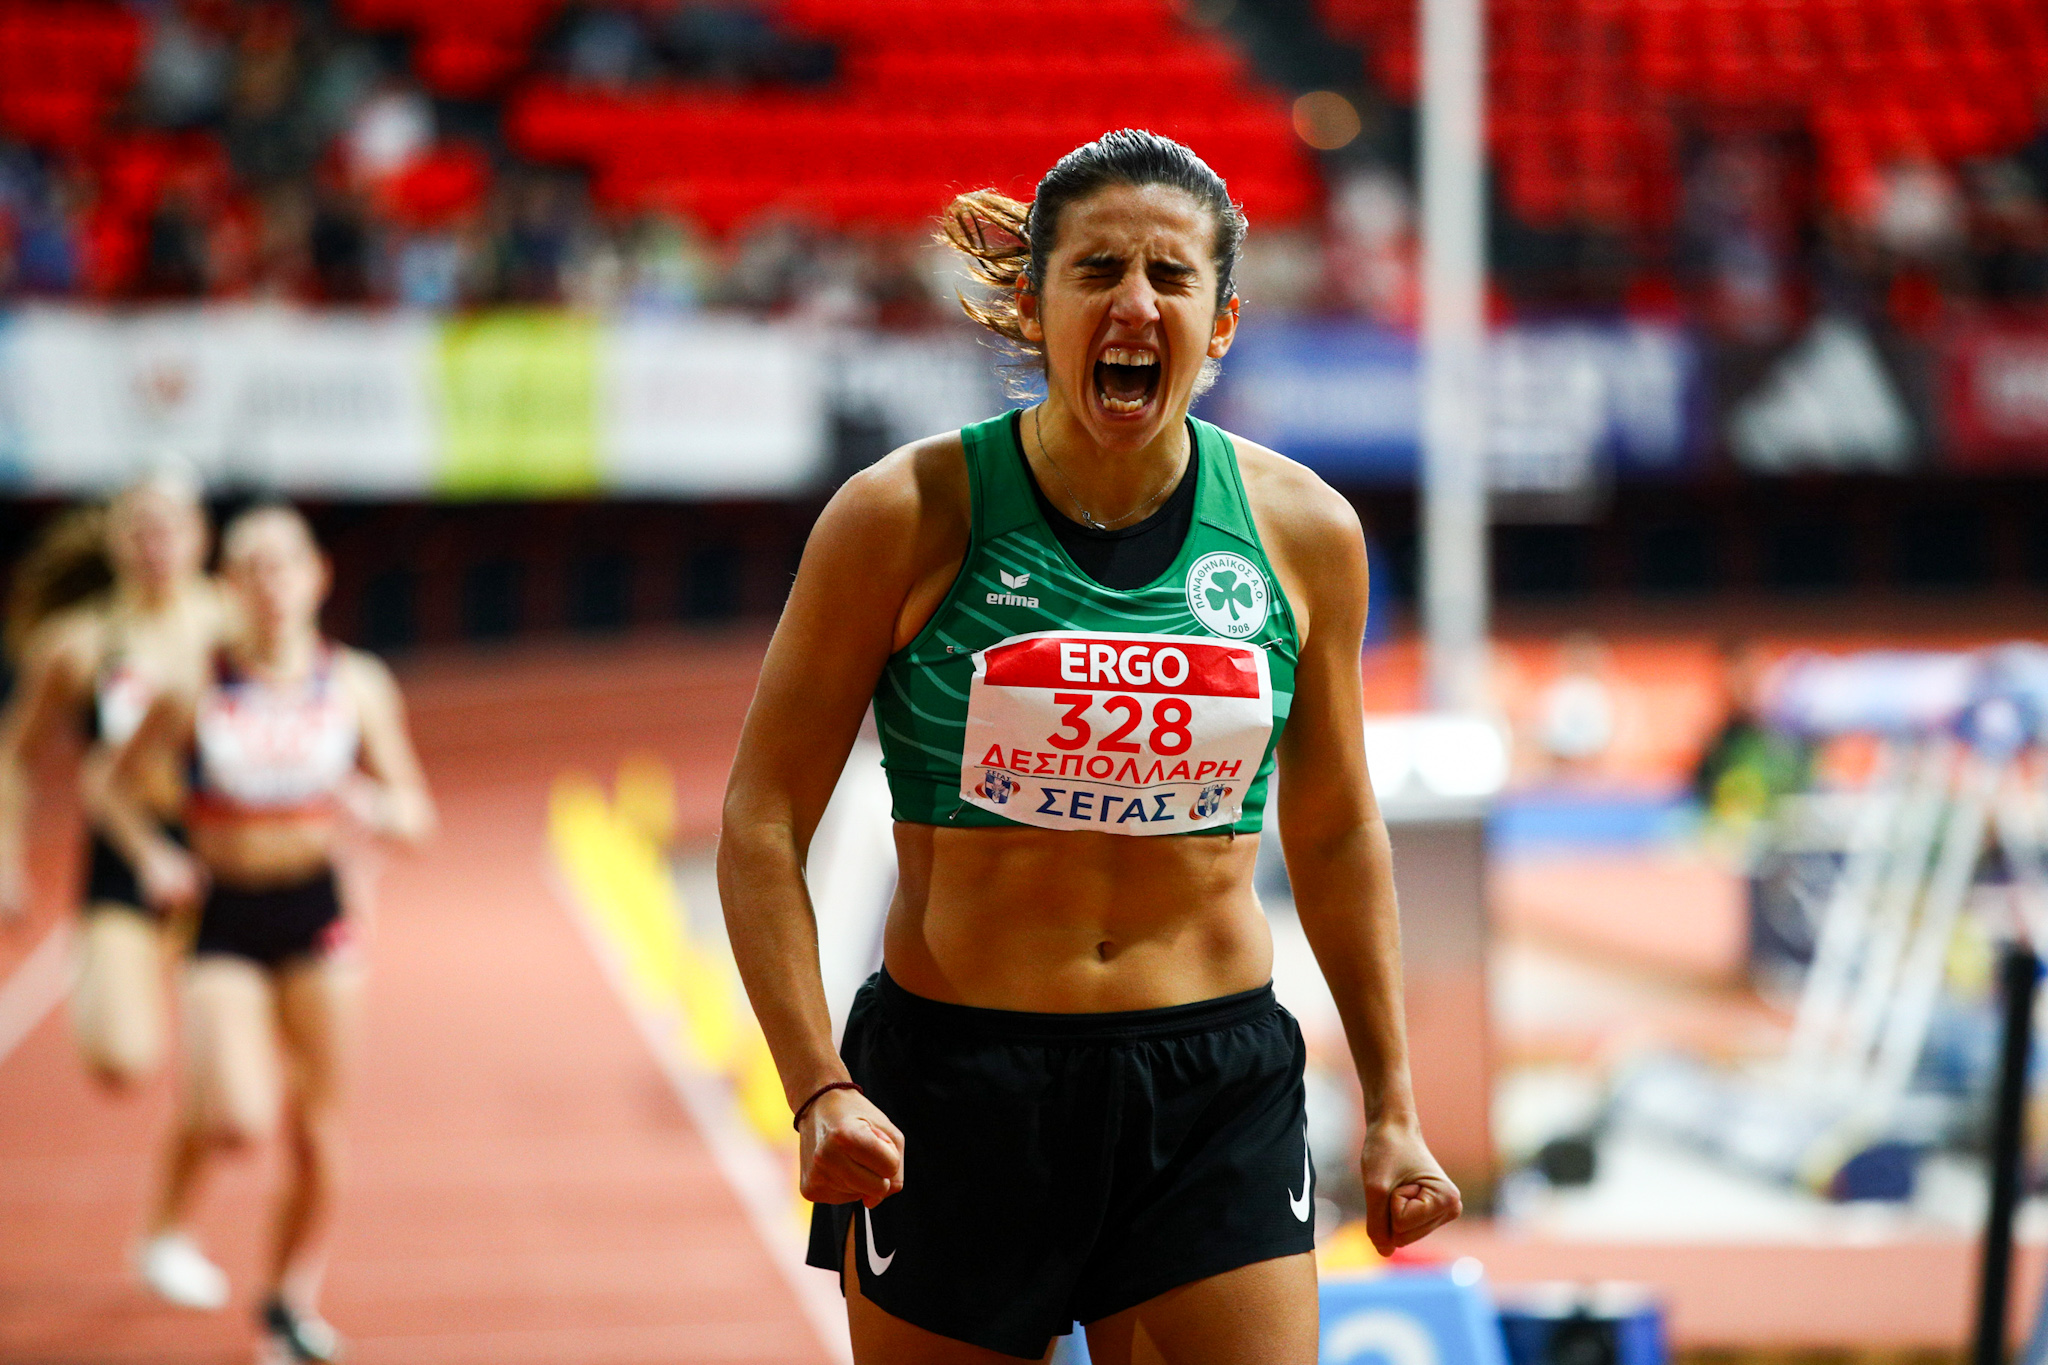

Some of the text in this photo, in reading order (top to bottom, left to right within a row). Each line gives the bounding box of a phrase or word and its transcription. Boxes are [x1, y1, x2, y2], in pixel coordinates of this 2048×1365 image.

[986, 591, 1039, 609] erima
[1227, 623, 1250, 634] 1908
[1059, 643, 1190, 687] ERGO
[1046, 692, 1193, 757] 328
[980, 743, 1242, 785] ΔΕΣΠΟΛΛΑΡΗ
[1036, 787, 1176, 823] ΣΕΓΑΣ
